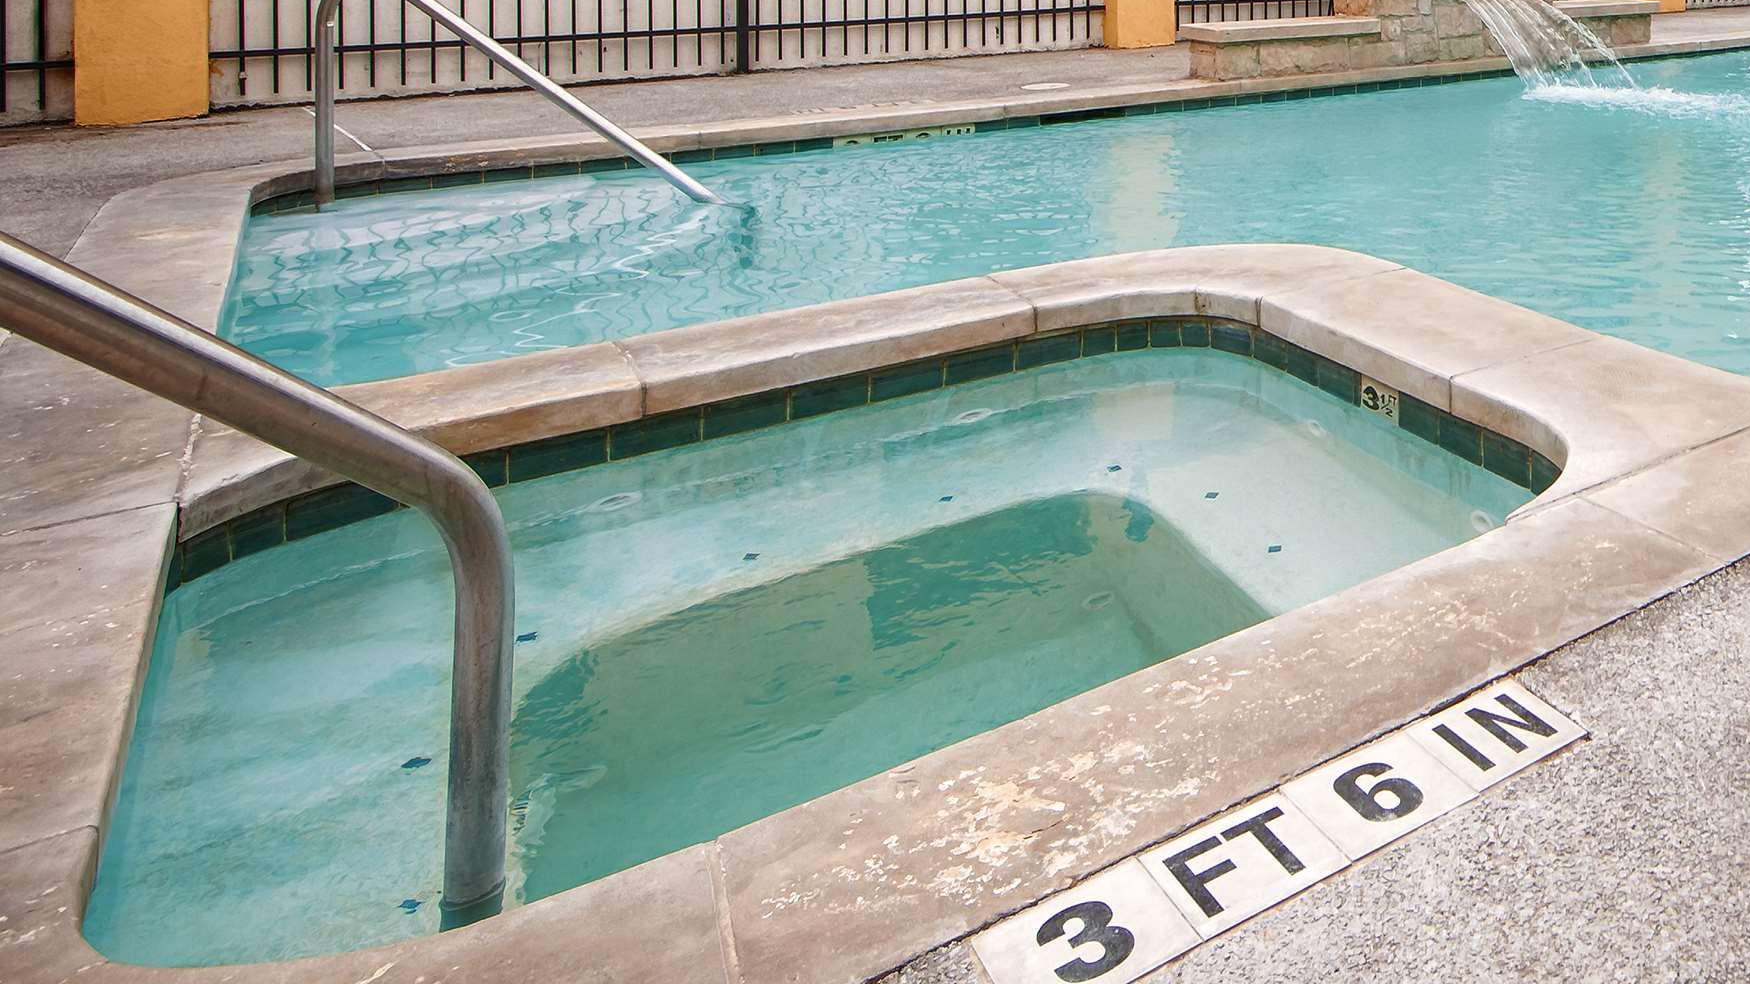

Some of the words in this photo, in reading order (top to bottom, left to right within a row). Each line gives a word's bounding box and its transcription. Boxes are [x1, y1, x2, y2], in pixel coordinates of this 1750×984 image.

[1035, 900, 1135, 983] 3
[1163, 806, 1306, 918] FT
[1332, 762, 1424, 823] 6
[1431, 693, 1558, 772] IN
